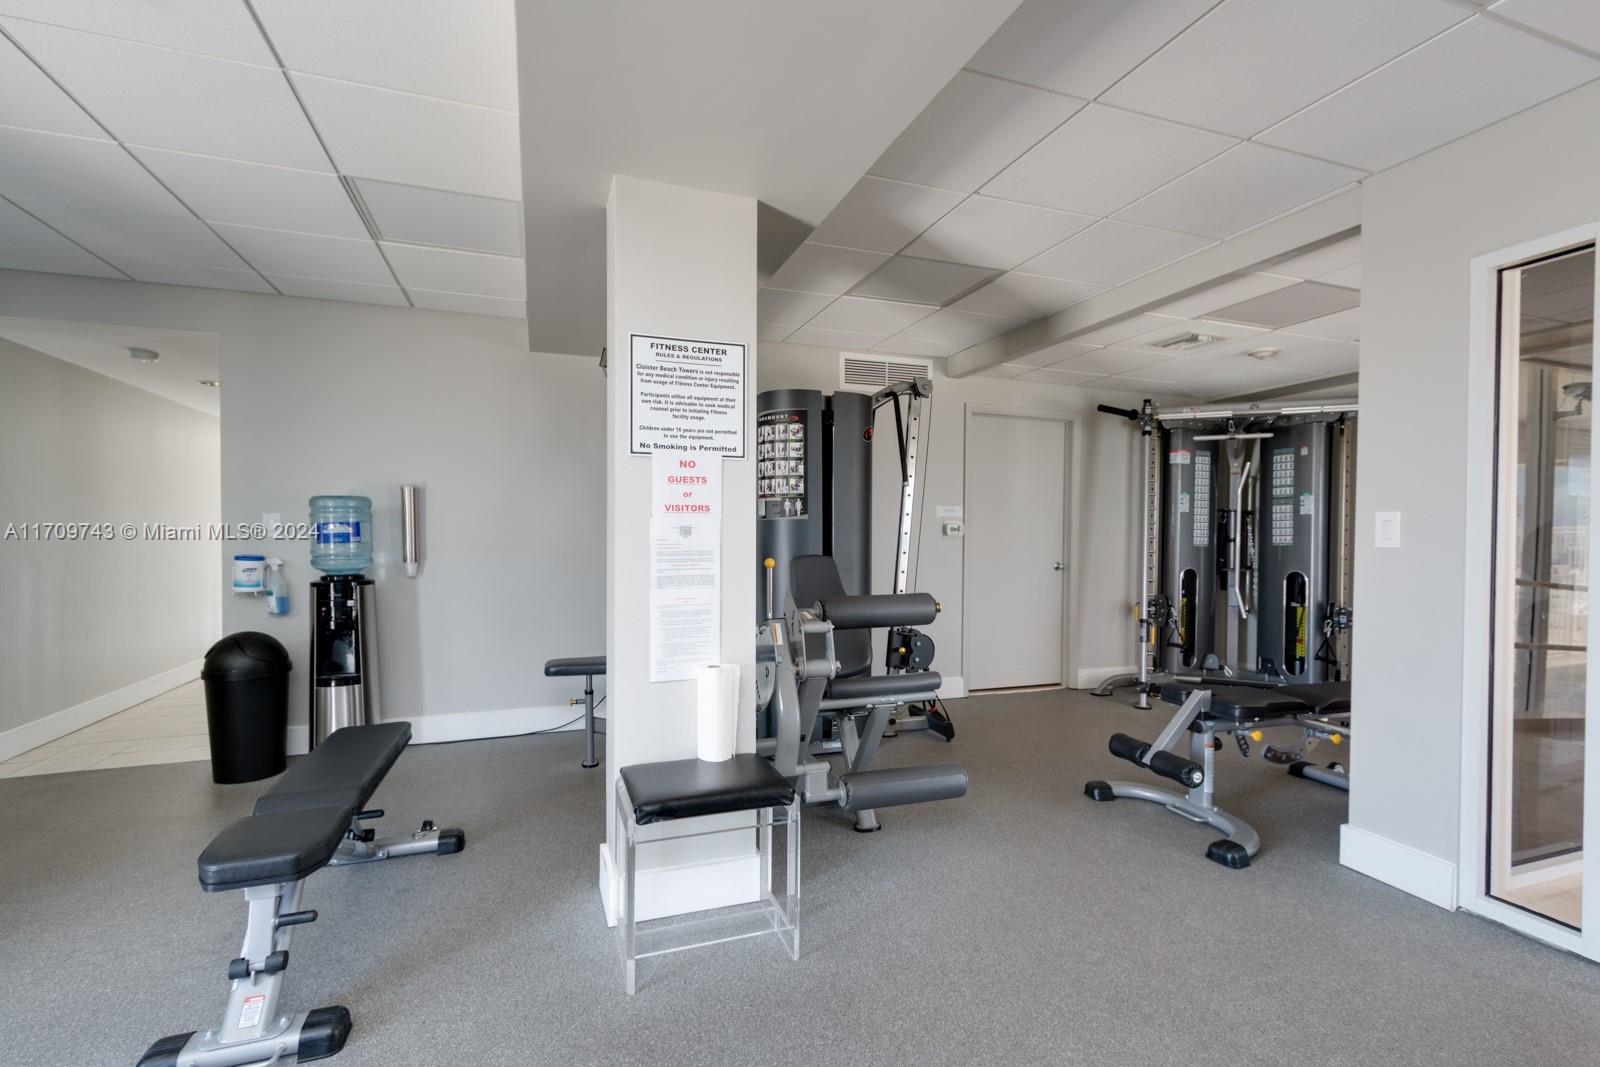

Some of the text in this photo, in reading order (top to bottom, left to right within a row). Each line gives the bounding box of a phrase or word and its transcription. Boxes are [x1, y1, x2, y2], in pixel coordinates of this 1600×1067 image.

[650, 342, 727, 356] FITNESS CENTER
[682, 354, 723, 362] REGULATIONS
[636, 363, 658, 371] Cloister
[713, 370, 740, 378] responsible
[719, 377, 740, 385] resulting
[672, 413, 689, 421] facility
[653, 442, 688, 451] Smoking
[699, 444, 737, 453] Permitted
[679, 459, 696, 469] NO
[667, 475, 708, 485] GUESTS
[664, 504, 711, 513] VISITORS
